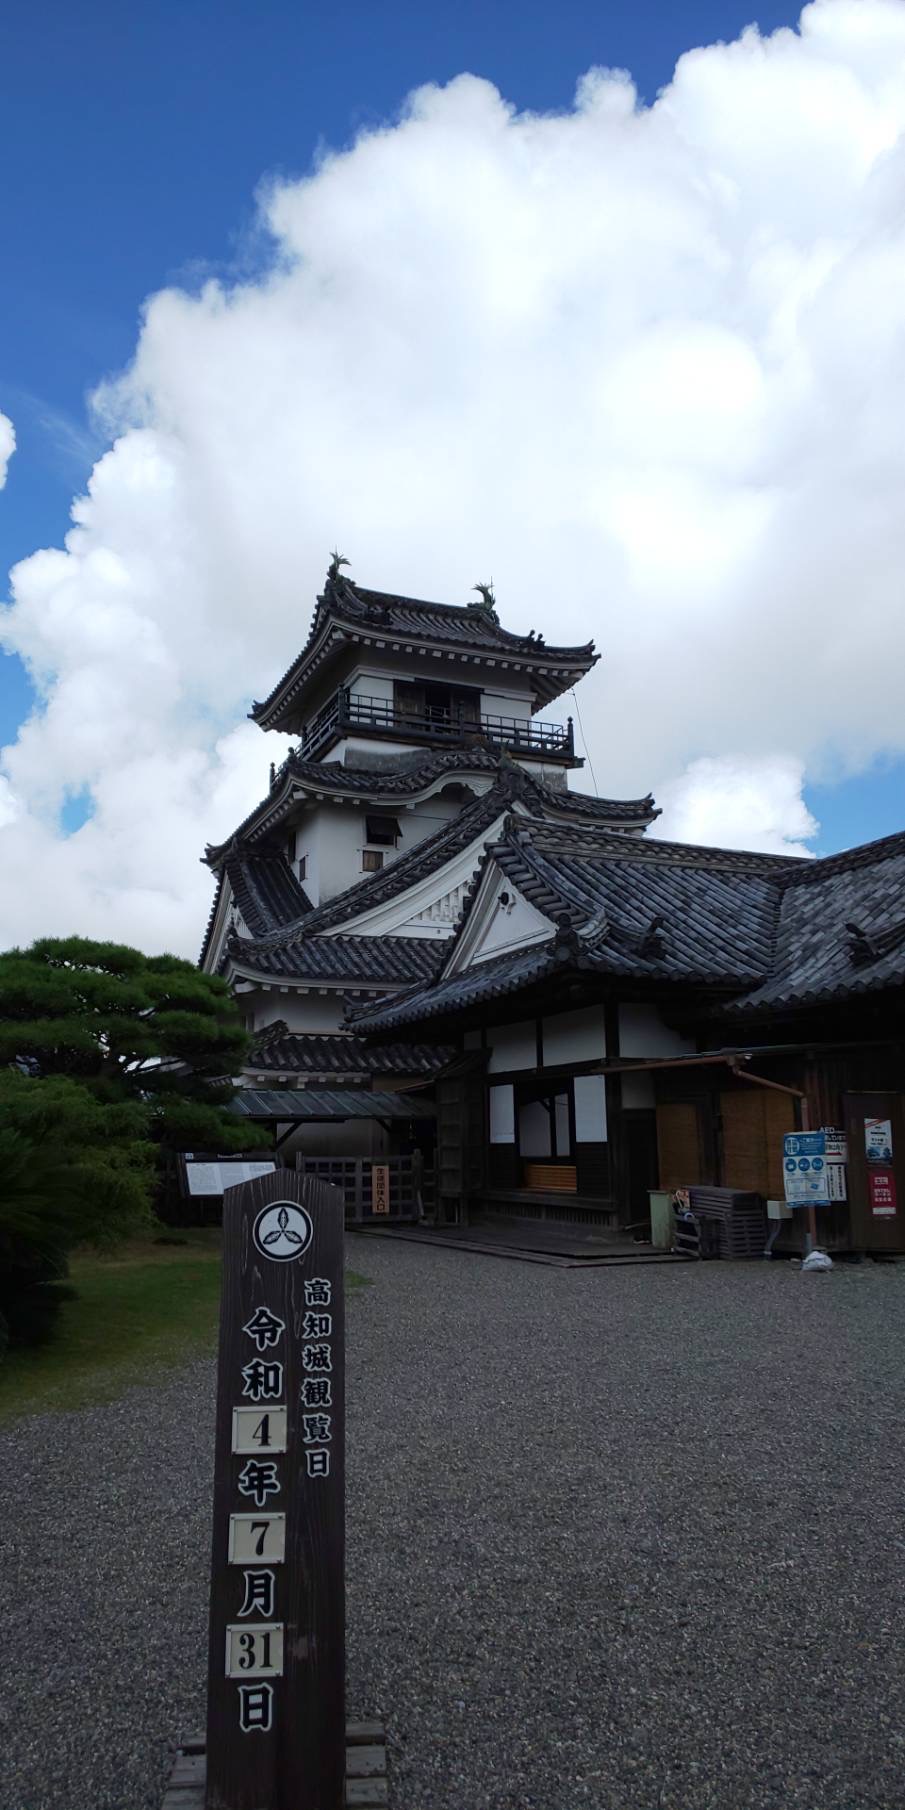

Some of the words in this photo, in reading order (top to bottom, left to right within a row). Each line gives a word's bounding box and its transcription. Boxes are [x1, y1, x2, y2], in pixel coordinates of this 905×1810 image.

[236, 1306, 286, 1732] 令和4年7月31日
[301, 1277, 332, 1478] 高知城観覧日
